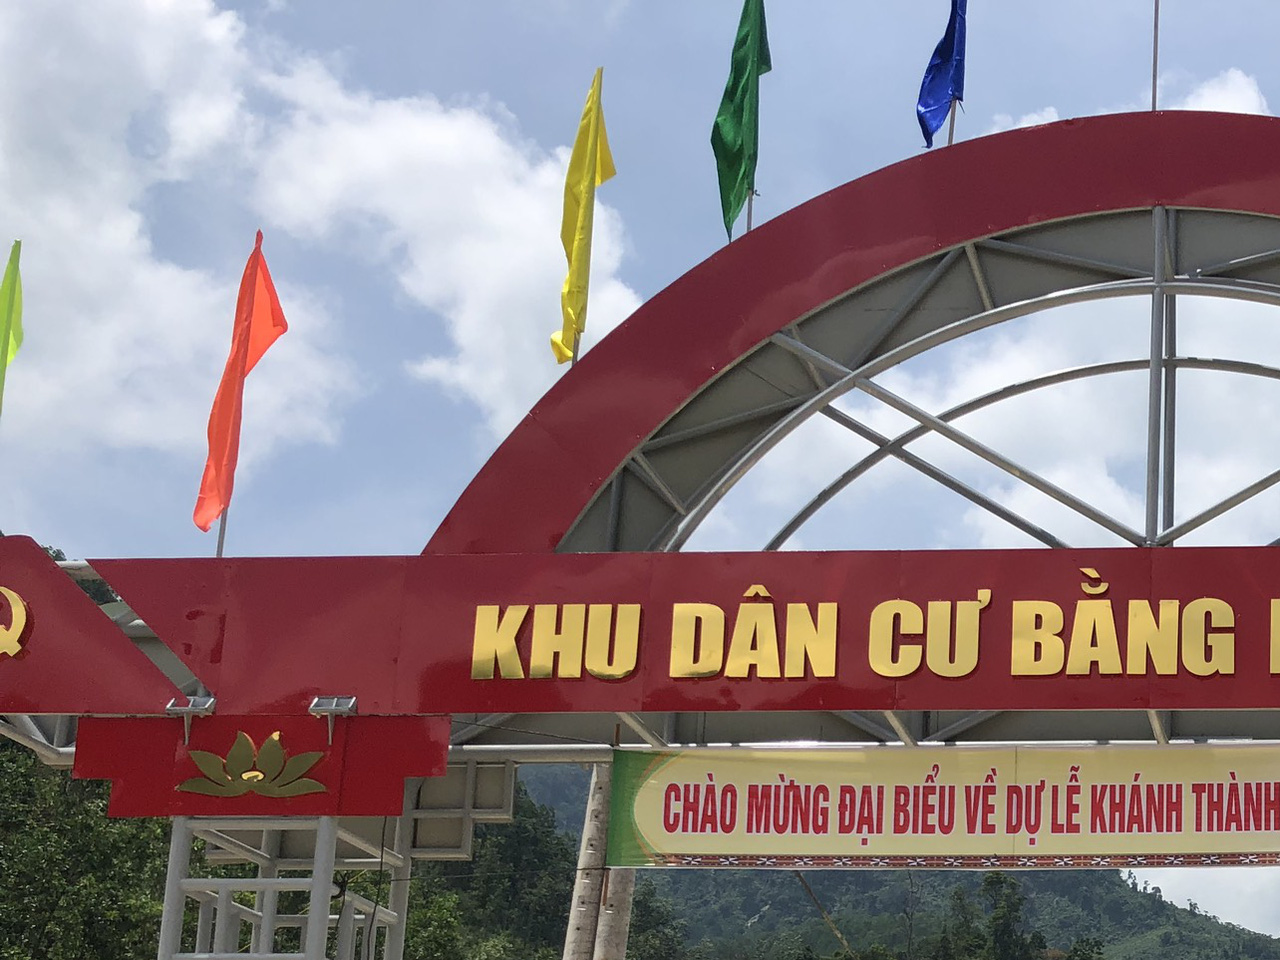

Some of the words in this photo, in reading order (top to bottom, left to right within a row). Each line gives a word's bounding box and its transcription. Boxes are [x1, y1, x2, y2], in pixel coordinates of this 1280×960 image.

[470, 603, 642, 680] KHU
[668, 584, 840, 678] DÂN
[867, 588, 991, 678] CƯ
[1010, 567, 1236, 677] BẰNG
[662, 772, 737, 834] CHÀO
[747, 773, 830, 836] MỪNG
[837, 784, 886, 846] ĐẠI
[892, 763, 956, 836] BIỂU
[964, 767, 999, 835] VỀ
[1006, 780, 1046, 846] DỰ
[1051, 765, 1083, 834] LỄ
[1090, 772, 1181, 834] KHÁNH
